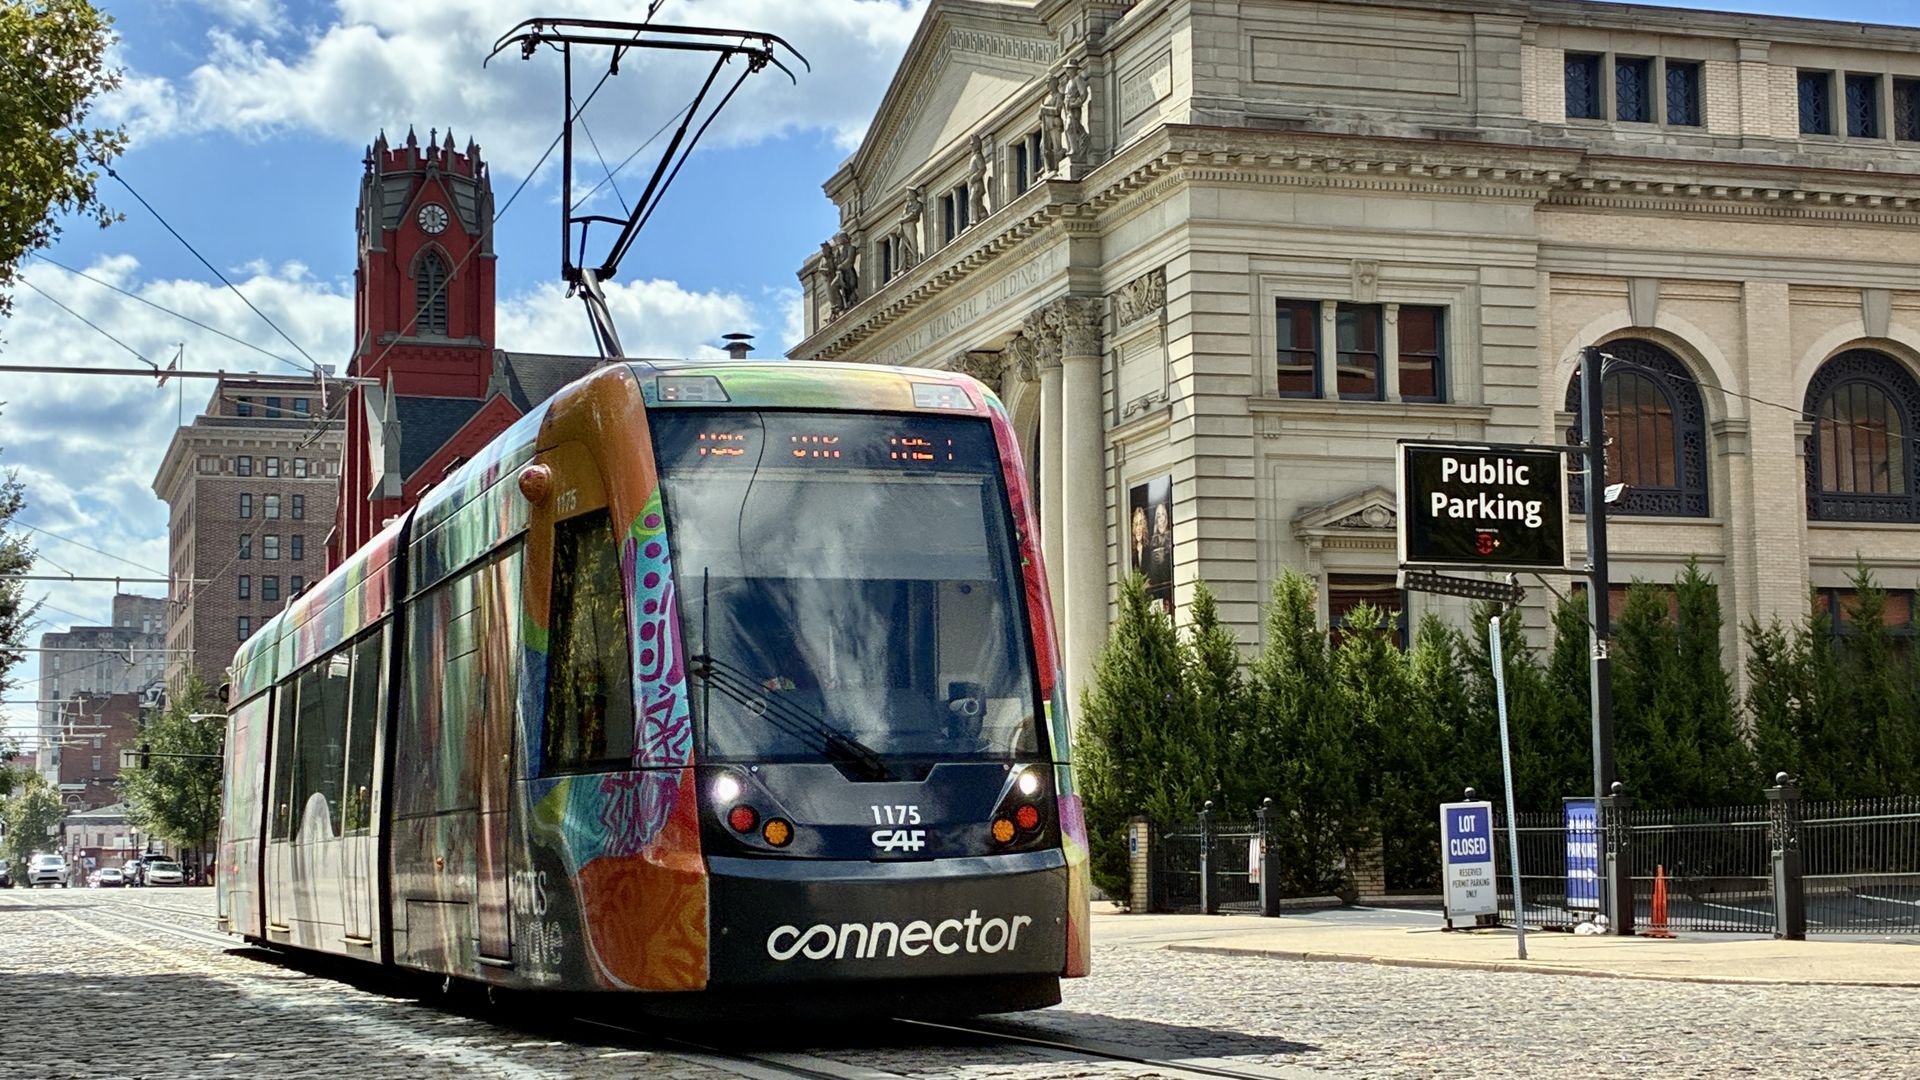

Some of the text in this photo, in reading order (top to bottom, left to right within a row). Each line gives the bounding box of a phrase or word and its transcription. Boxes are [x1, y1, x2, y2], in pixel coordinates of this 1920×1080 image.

[887, 261, 1040, 365] COUNTY MEMORIAL BUILDING
[1441, 457, 1530, 486] Public
[556, 489, 577, 512] 1175
[1431, 492, 1543, 528] Parking
[871, 805, 921, 825] 1175
[1458, 815, 1476, 833] LOT
[871, 829, 926, 851] CAF
[1450, 837, 1487, 856] CLOSED
[1459, 868, 1482, 877] RESERVED
[1453, 878, 1490, 889] PERMIT PARKING
[1465, 889, 1478, 898] ONLY
[766, 909, 1032, 961] connector
